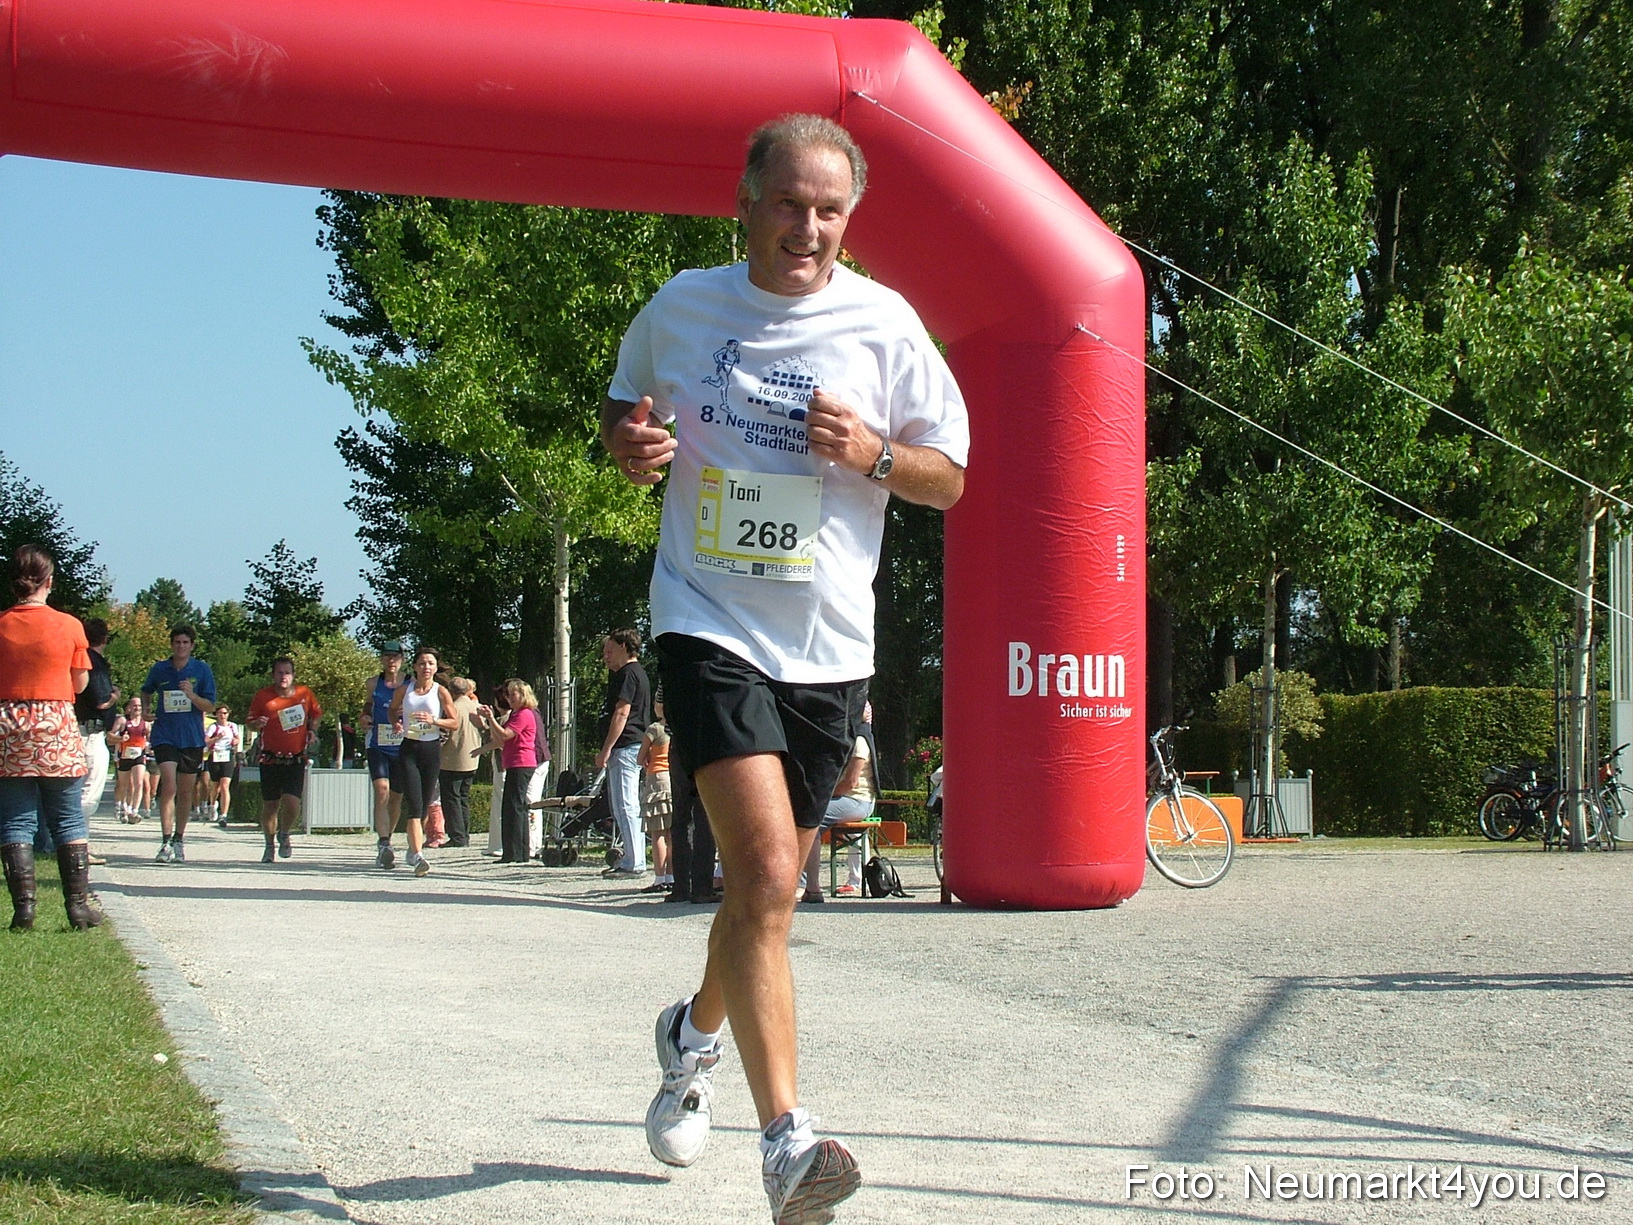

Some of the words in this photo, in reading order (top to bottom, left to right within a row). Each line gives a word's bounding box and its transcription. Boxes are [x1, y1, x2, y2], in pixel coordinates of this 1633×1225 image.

[757, 386, 813, 403] 16.09.200
[700, 405, 721, 424] 8.
[728, 479, 761, 502] Toni
[701, 506, 708, 520] D
[736, 519, 798, 551] 268
[766, 563, 812, 574] PFLEIDERER
[1008, 641, 1126, 698] Braun
[173, 699, 188, 707] 915
[1060, 702, 1093, 718] Sicher
[1095, 704, 1107, 718] ist
[1109, 703, 1133, 718] sicher
